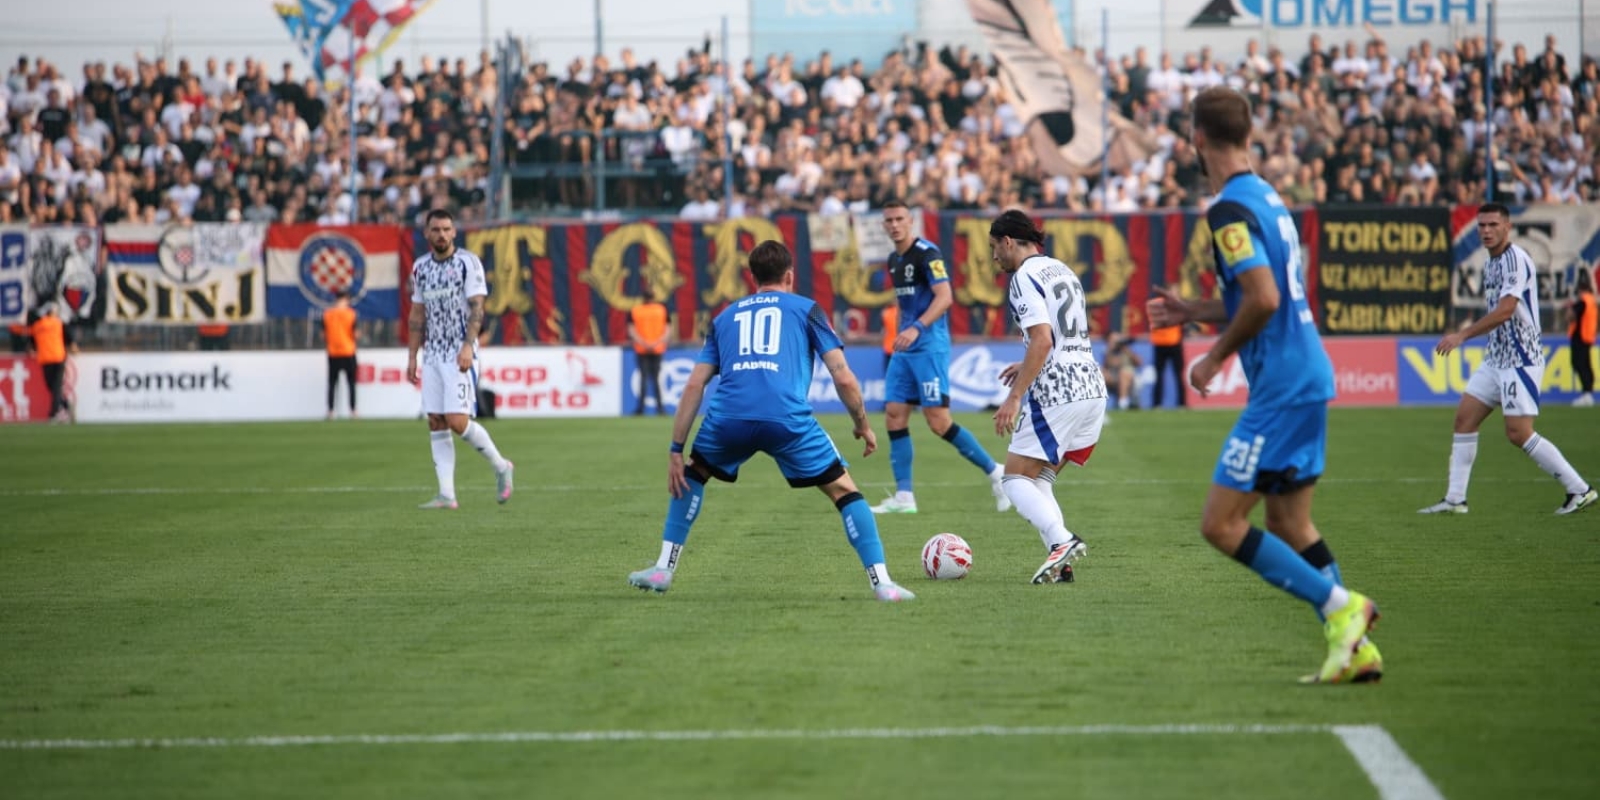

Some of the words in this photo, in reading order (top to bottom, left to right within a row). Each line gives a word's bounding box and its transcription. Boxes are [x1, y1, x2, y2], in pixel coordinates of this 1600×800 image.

[1324, 221, 1447, 253] TORCIDA
[116, 270, 256, 319] SINJ
[738, 296, 779, 308] BELCAR
[734, 306, 782, 356] 10
[732, 360, 779, 373] RADNIK
[101, 365, 231, 391] Bomark
[494, 388, 589, 409] erto
[922, 381, 934, 398] 17
[1503, 381, 1517, 399] 14
